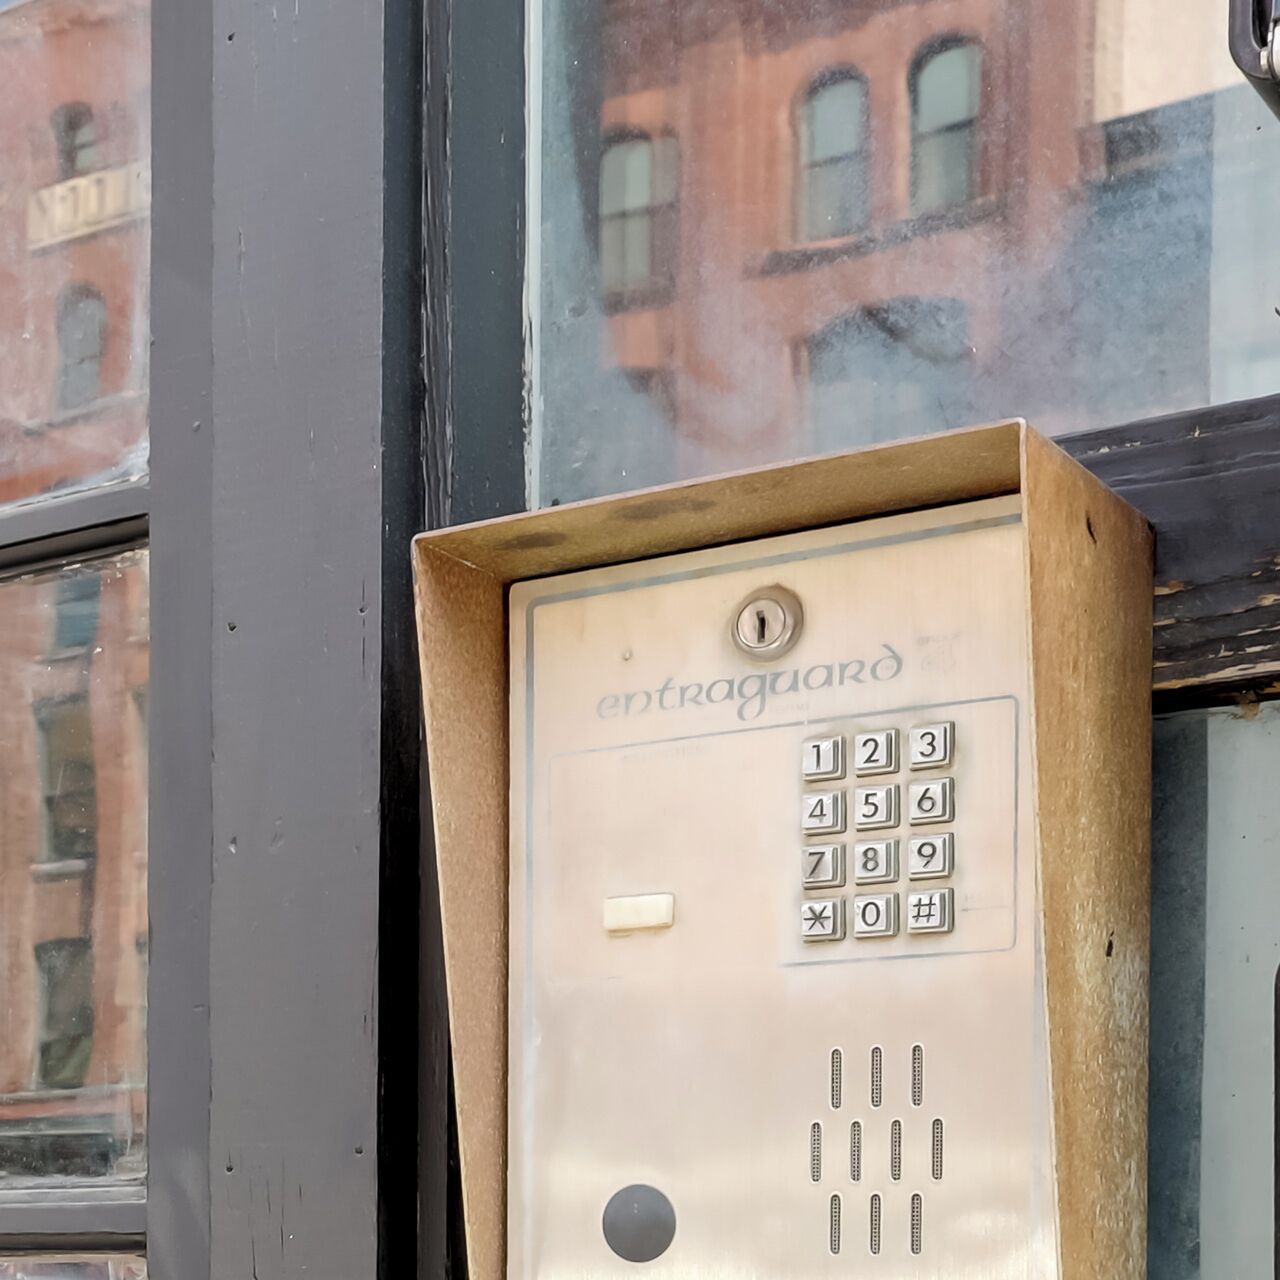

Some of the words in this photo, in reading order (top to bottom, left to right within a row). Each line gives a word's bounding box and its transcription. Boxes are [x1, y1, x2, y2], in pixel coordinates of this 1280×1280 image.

[596, 644, 904, 721] entraguard
[811, 744, 822, 770] 1
[861, 738, 880, 764] 2
[919, 731, 937, 757] 3
[808, 798, 827, 822] 4
[861, 792, 879, 818] 5
[916, 787, 936, 812] 6
[807, 851, 826, 878] 7
[862, 847, 880, 871] 8
[917, 842, 937, 868] 9
[861, 901, 881, 926] 0
